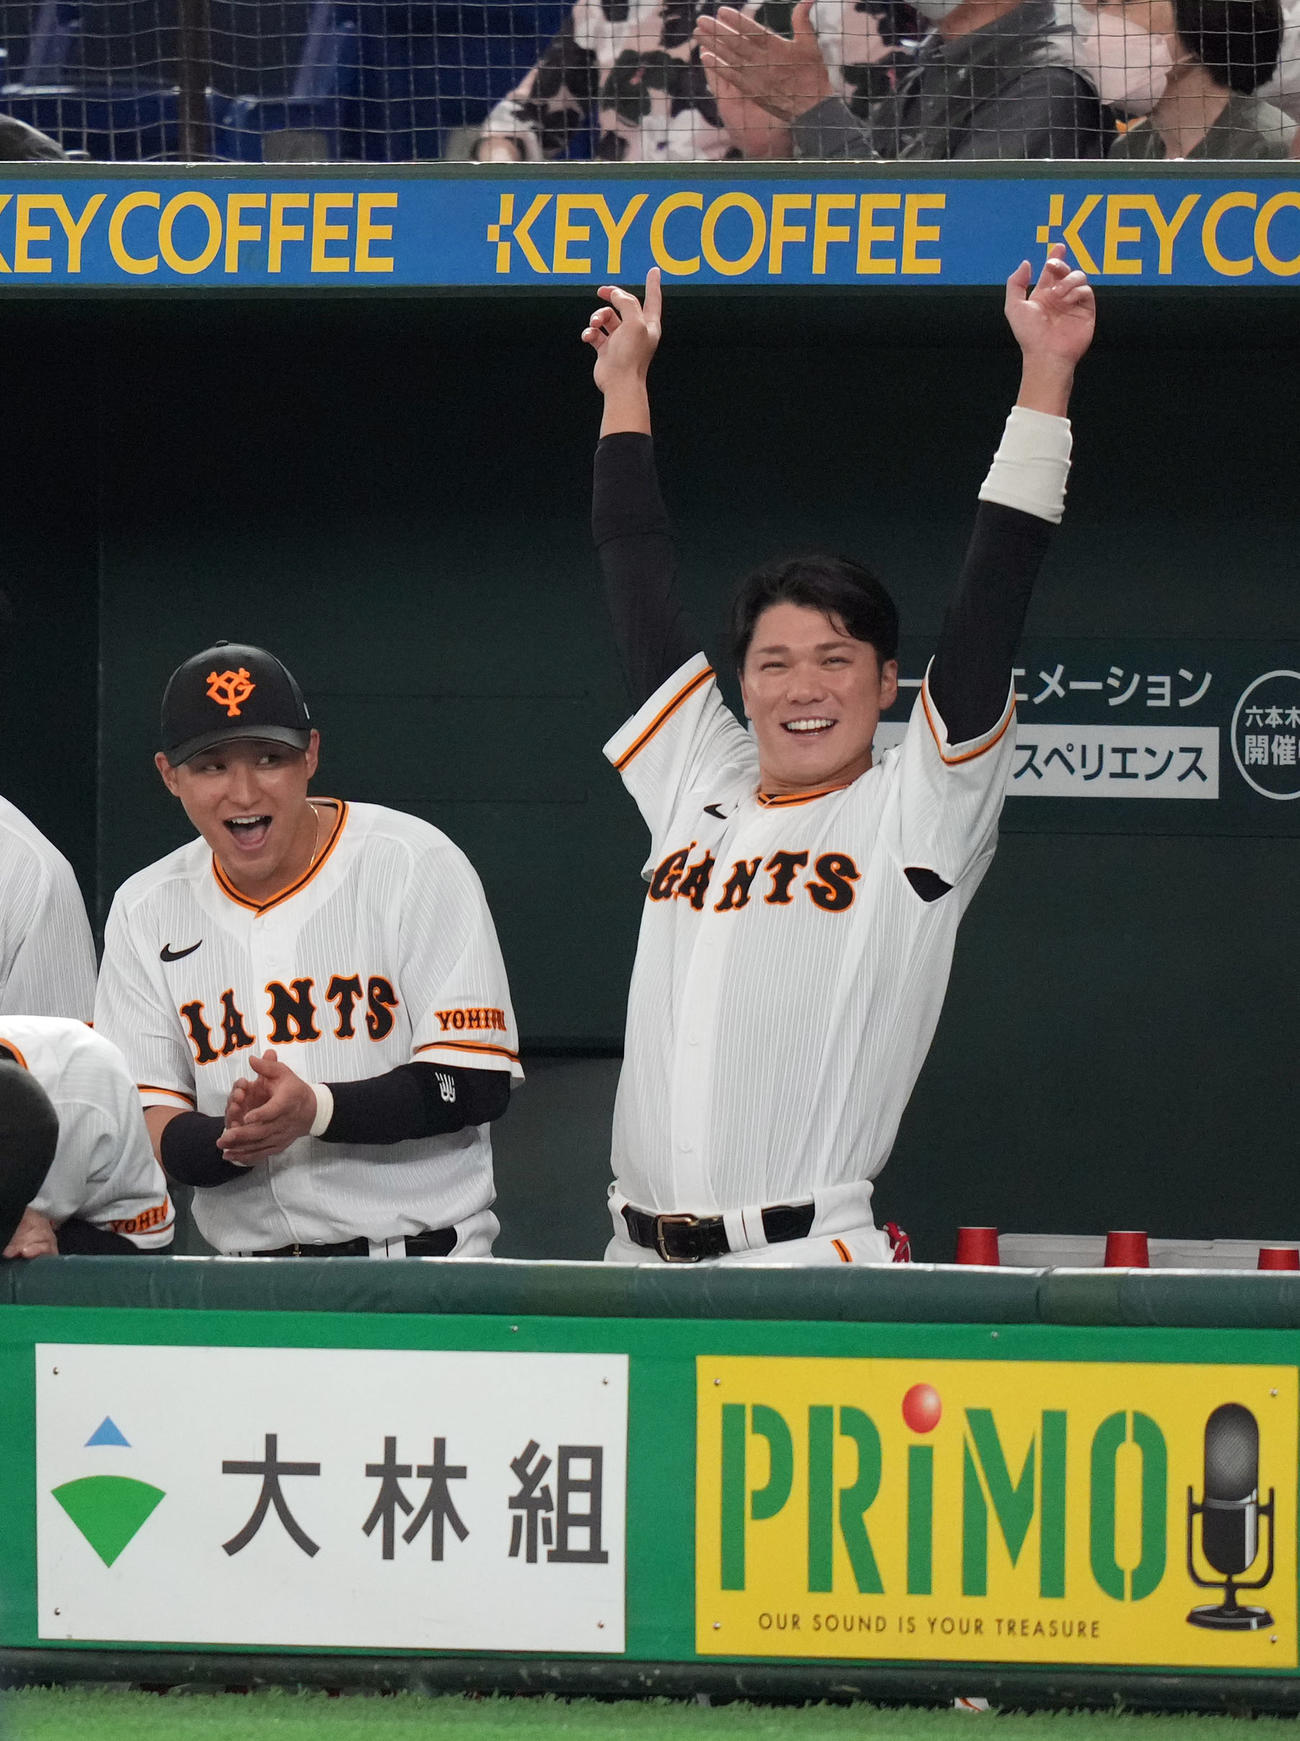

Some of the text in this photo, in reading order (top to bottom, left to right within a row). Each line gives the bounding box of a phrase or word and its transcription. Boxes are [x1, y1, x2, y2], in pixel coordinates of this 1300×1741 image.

[1244, 734, 1300, 766] 開催
[649, 841, 862, 913] GANTS
[221, 1433, 609, 1564] 大林組
[758, 1612, 1100, 1638] OUR SOUND IS YOUR TREASURE
